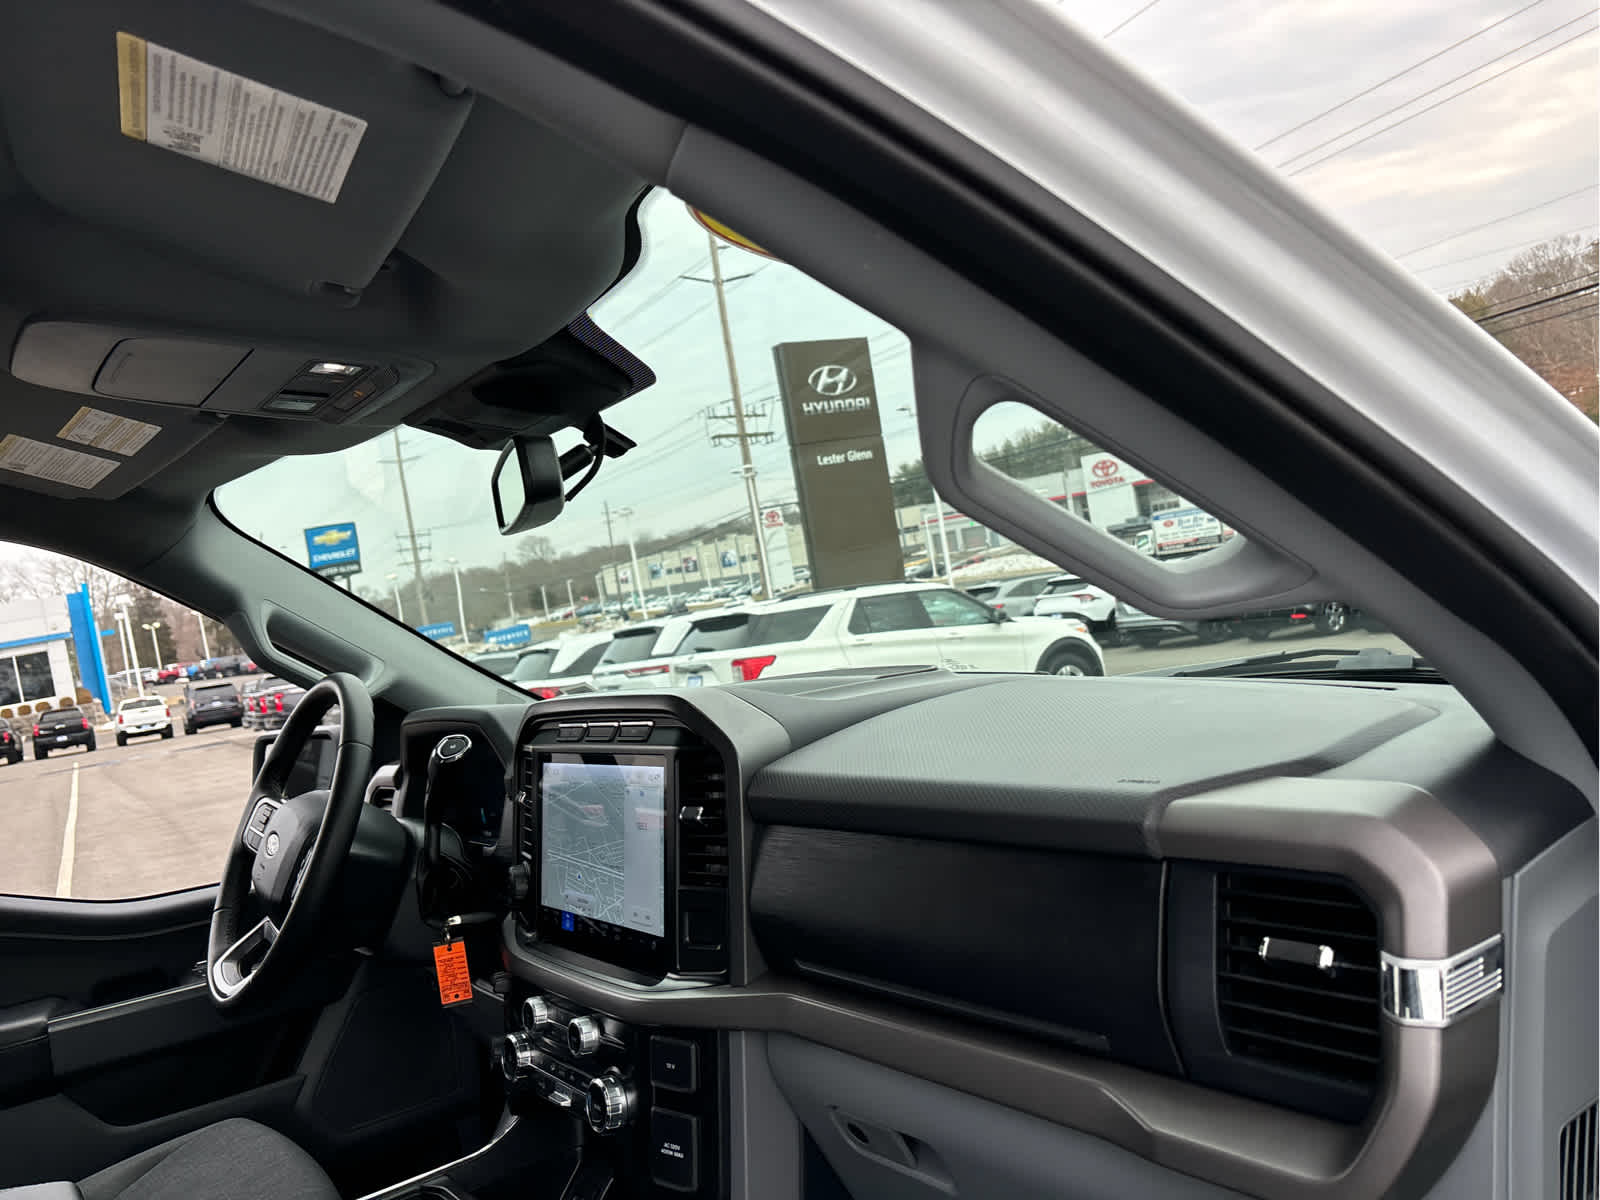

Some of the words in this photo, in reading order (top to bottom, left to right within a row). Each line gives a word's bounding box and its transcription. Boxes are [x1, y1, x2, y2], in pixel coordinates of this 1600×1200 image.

[802, 397, 871, 415] HYUNDAI
[817, 453, 845, 466] Lester
[847, 450, 873, 462] Glenn
[1090, 476, 1125, 488] TOYOTA
[312, 547, 356, 563] CHEVROLET
